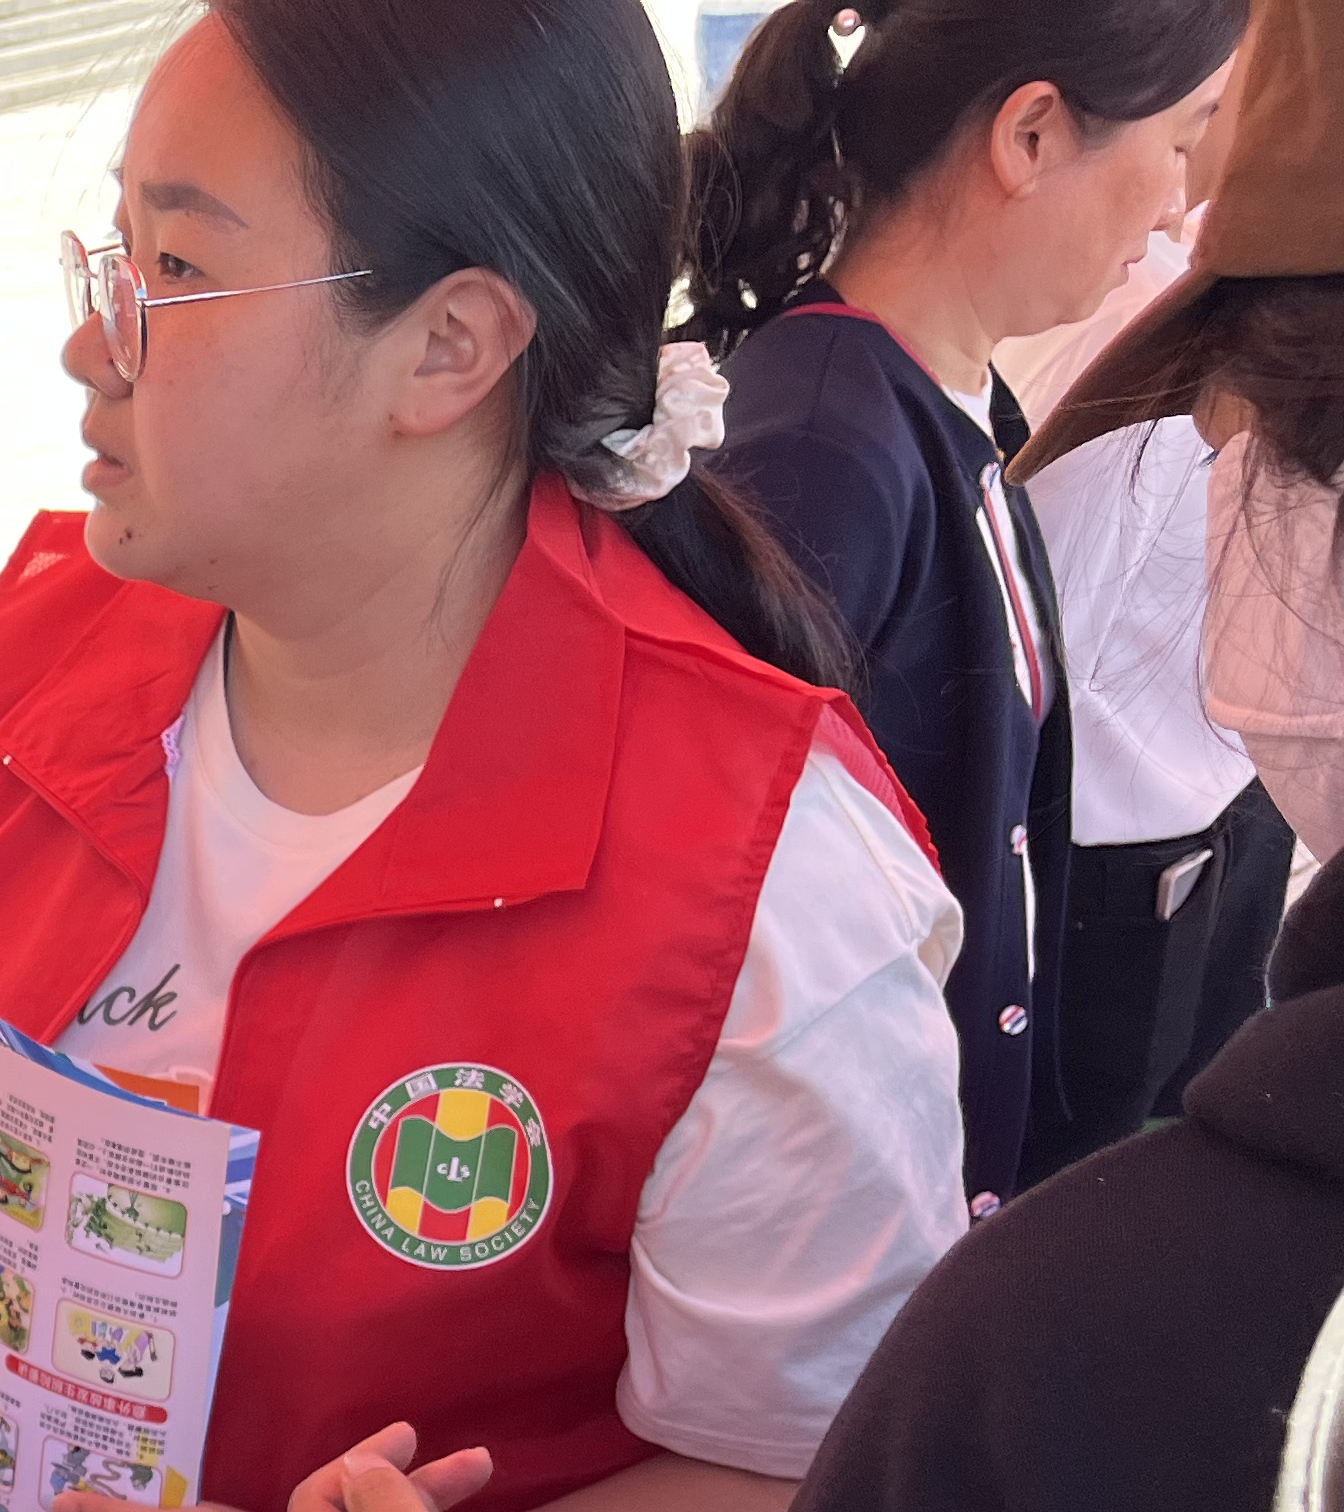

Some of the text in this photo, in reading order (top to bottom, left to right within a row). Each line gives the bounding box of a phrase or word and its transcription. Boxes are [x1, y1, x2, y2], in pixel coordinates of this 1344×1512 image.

[369, 1068, 542, 1147] 中国法学会
[355, 1179, 542, 1262] CHINA LAW SOCIETY
